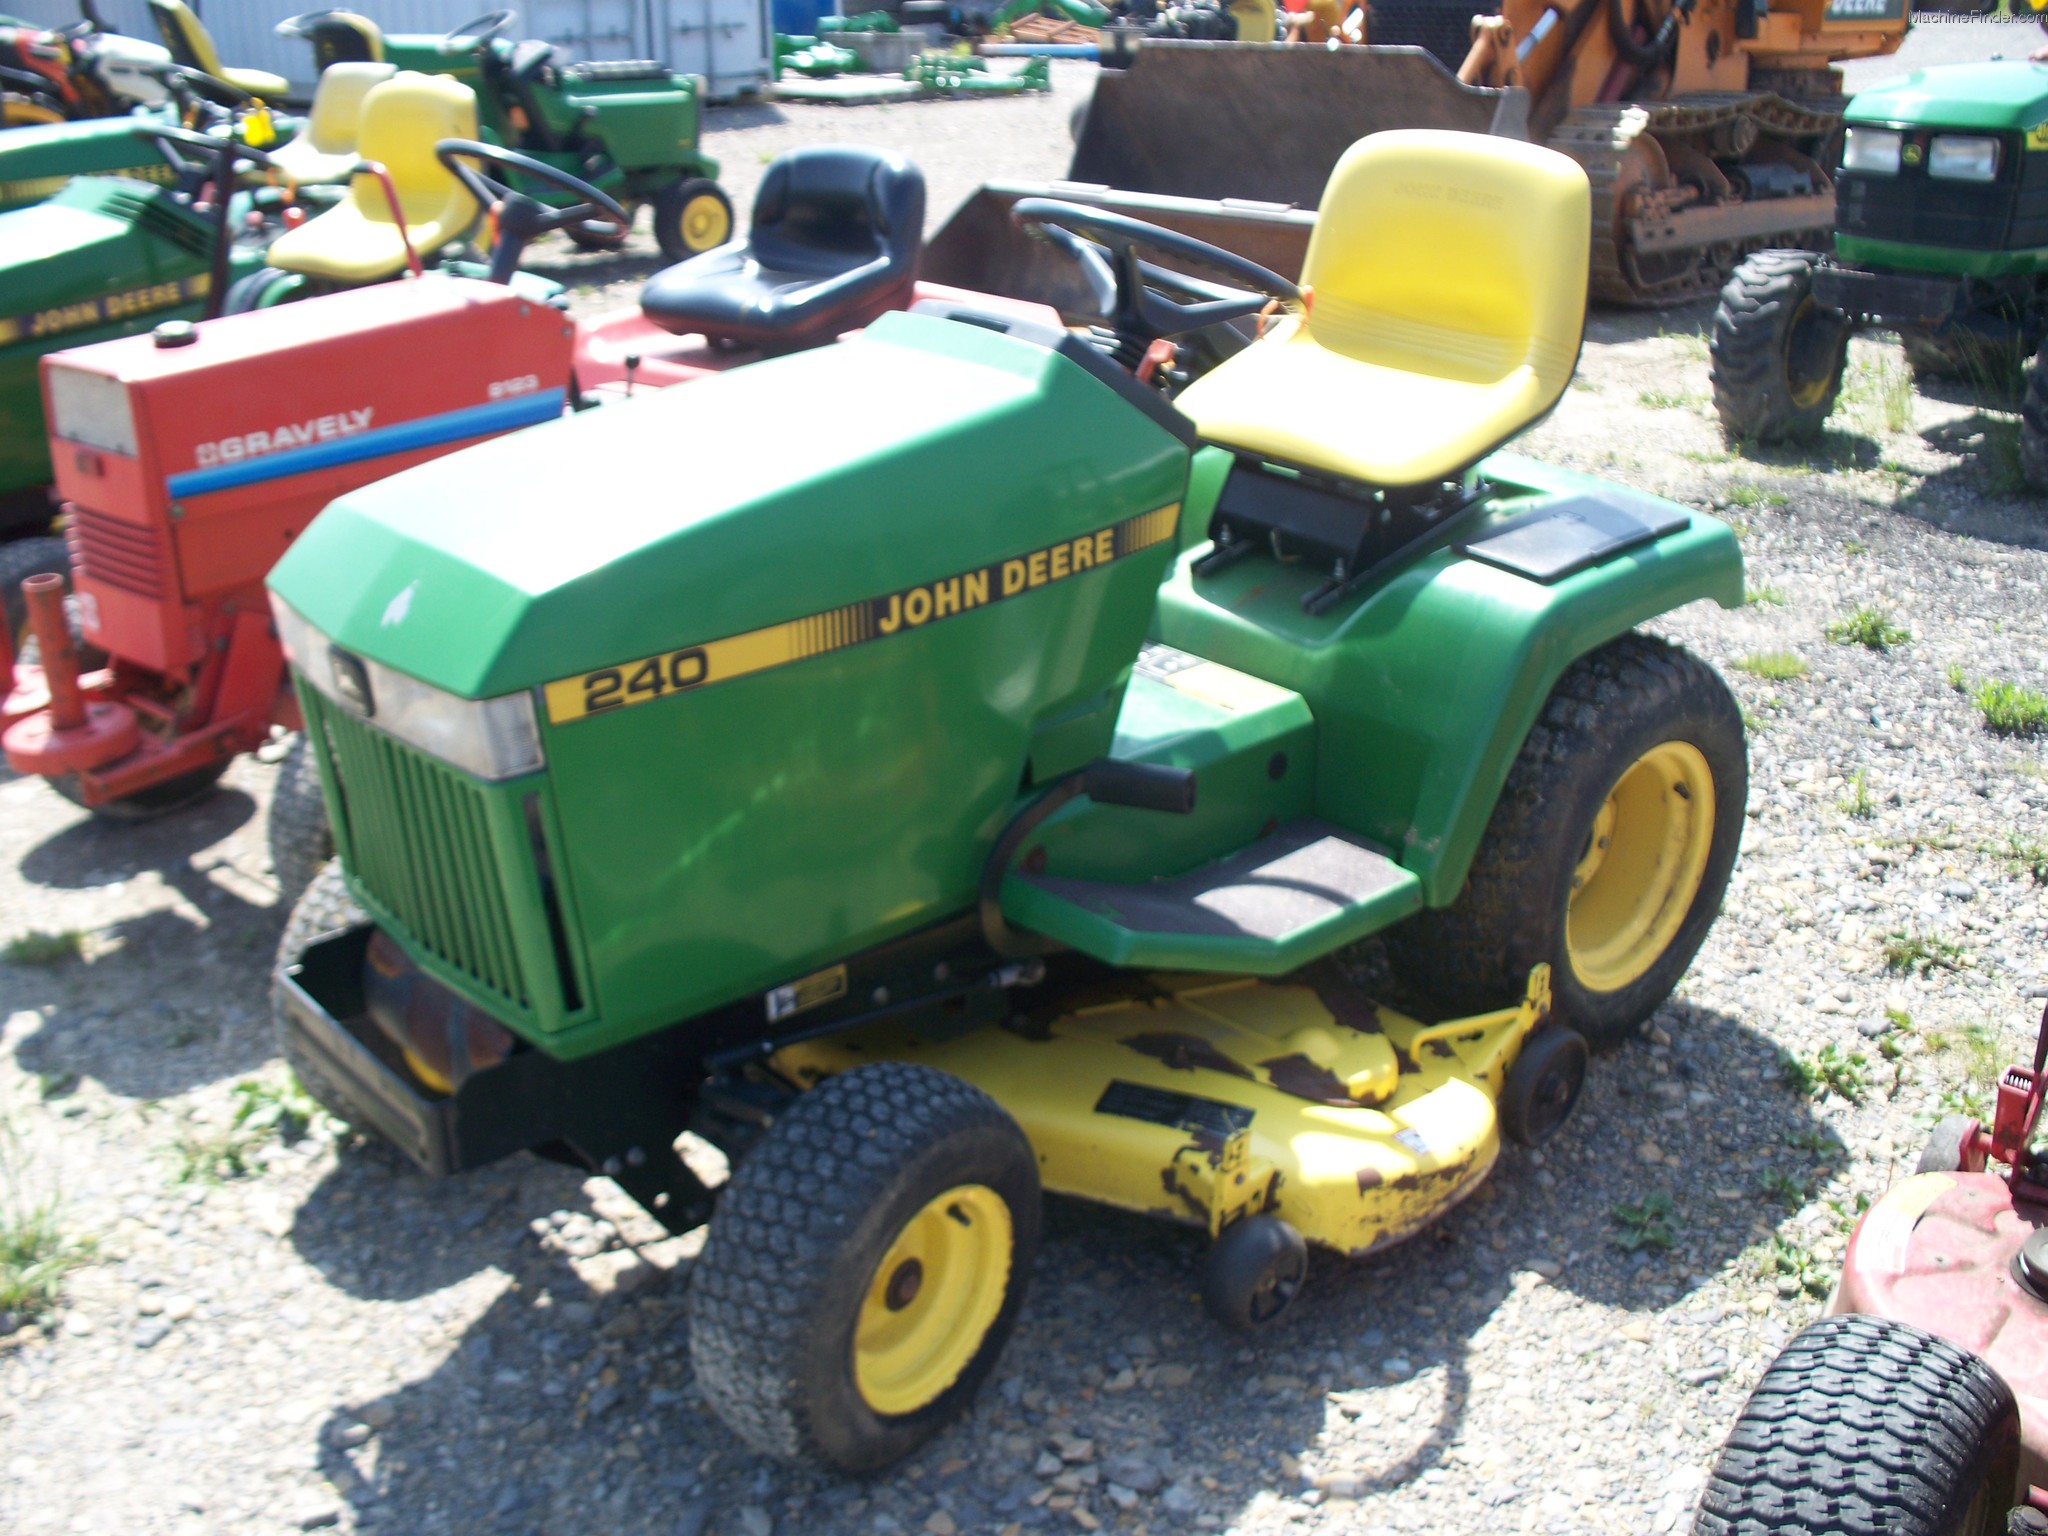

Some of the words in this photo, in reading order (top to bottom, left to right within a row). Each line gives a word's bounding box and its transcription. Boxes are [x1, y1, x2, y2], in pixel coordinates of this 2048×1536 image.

[31, 300, 99, 336] JOHN
[105, 281, 181, 316] DEERE
[219, 407, 374, 461] GRAVELY
[877, 569, 989, 634] JOHN
[1002, 528, 1115, 596] DEERE
[583, 645, 709, 712] 240
